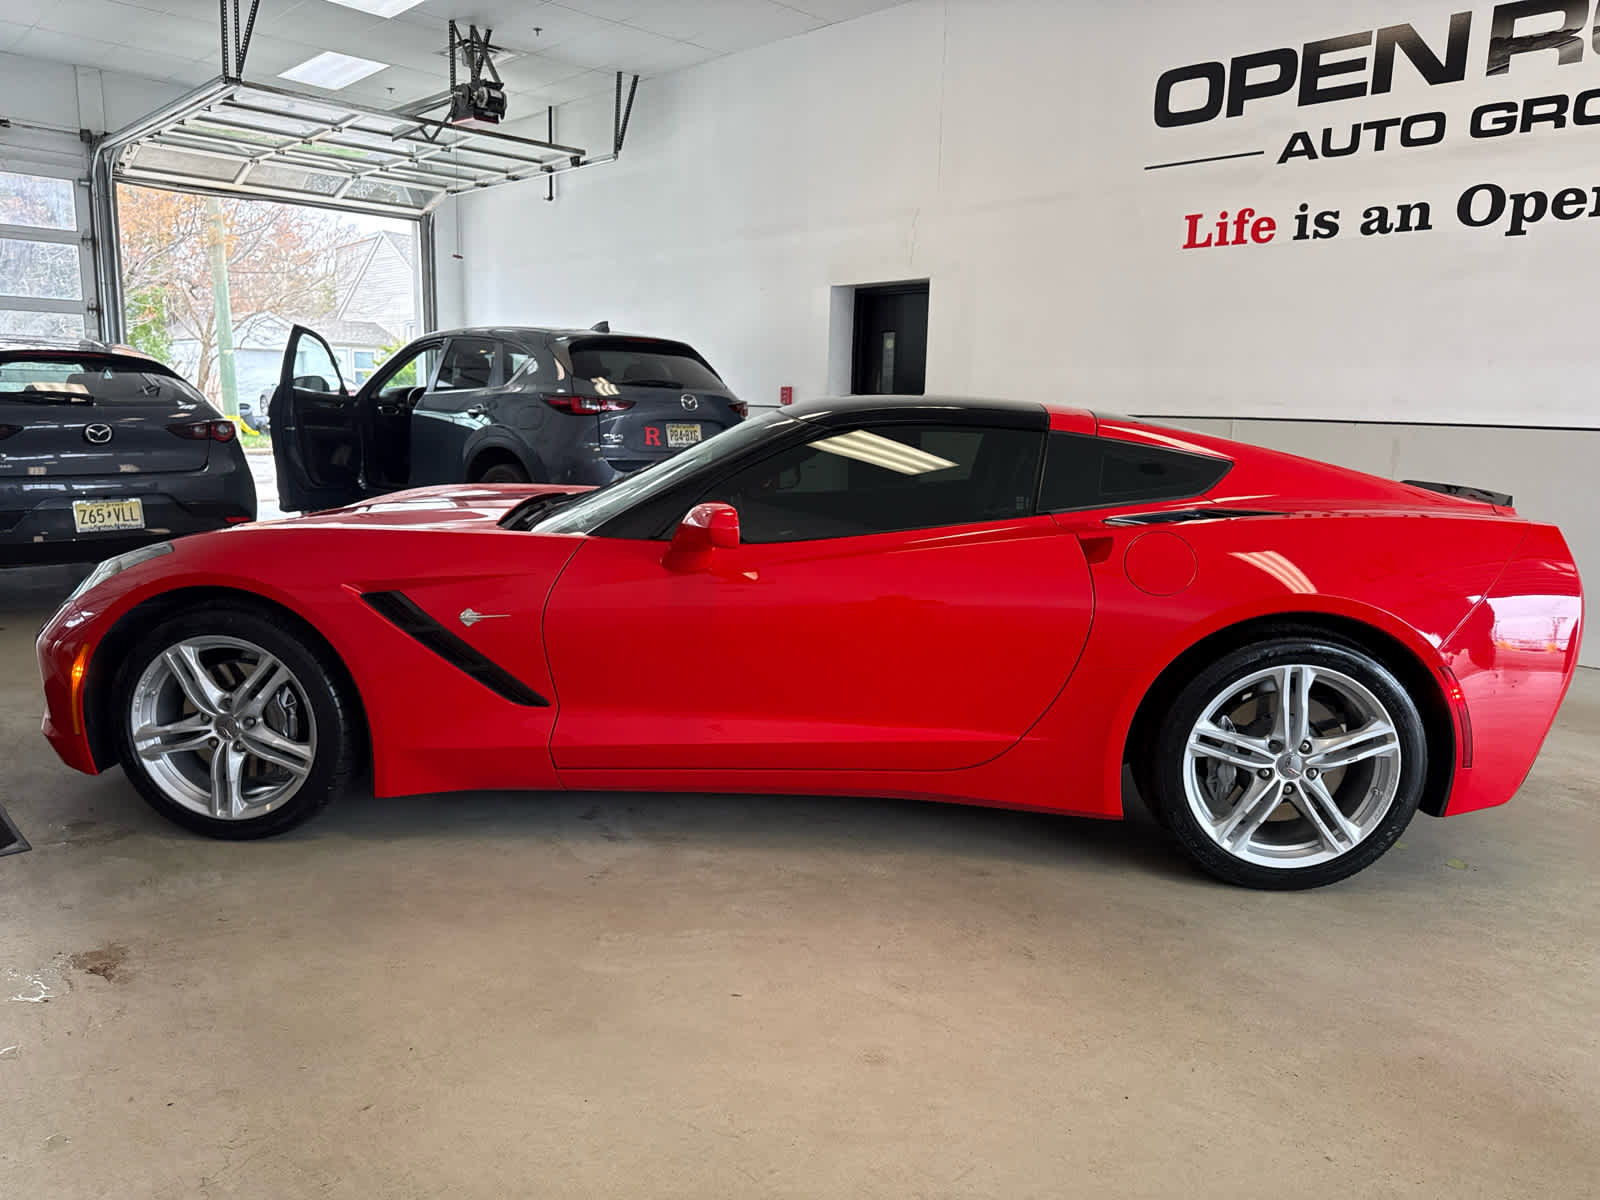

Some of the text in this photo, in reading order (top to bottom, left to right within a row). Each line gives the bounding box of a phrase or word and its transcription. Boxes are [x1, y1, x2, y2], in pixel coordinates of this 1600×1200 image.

[1154, 0, 1600, 129] OPEN R
[1276, 112, 1447, 165] AUTO
[1182, 183, 1600, 250] Life is an Ope
[644, 426, 662, 446] R
